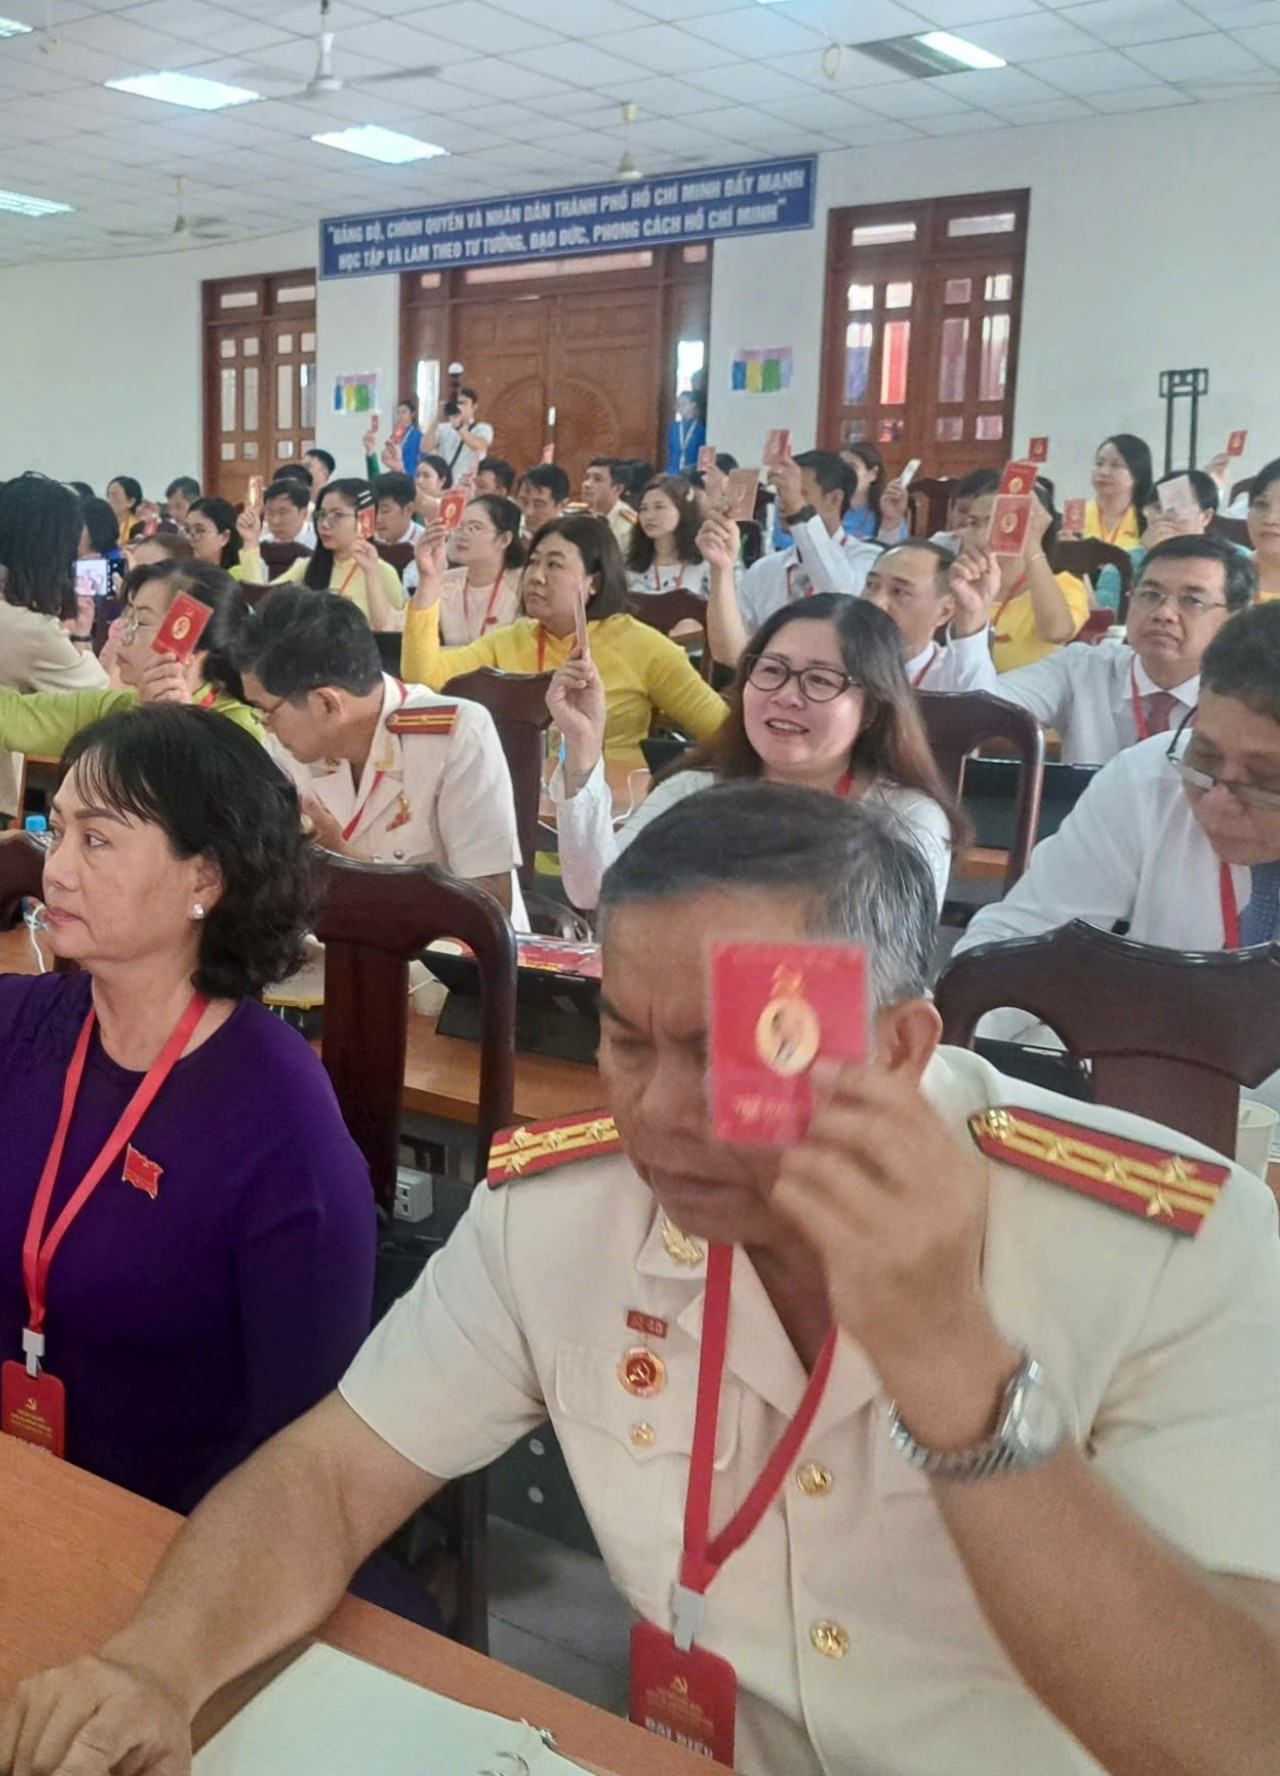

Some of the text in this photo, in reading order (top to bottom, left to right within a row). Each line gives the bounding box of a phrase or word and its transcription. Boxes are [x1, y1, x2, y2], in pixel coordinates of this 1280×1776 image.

[425, 211, 465, 236] QUYỀN
[466, 209, 483, 230] VÀ
[555, 195, 598, 219] THÀNH
[600, 187, 629, 213] PHỐ
[631, 184, 651, 209] HỒ
[654, 181, 679, 206] CHÍ
[681, 179, 722, 203] MINH
[757, 169, 805, 196] MẠNH
[338, 252, 361, 273] HỌC
[364, 247, 385, 270] TẬP
[387, 245, 402, 265] VÀ
[404, 243, 430, 263] LÀM
[433, 240, 462, 261] THEO
[530, 230, 557, 252] ĐẠO
[593, 219, 641, 243] PHONG
[643, 214, 682, 237] CÁCH
[684, 207, 705, 233] HỒ
[707, 205, 734, 230] CHÍ
